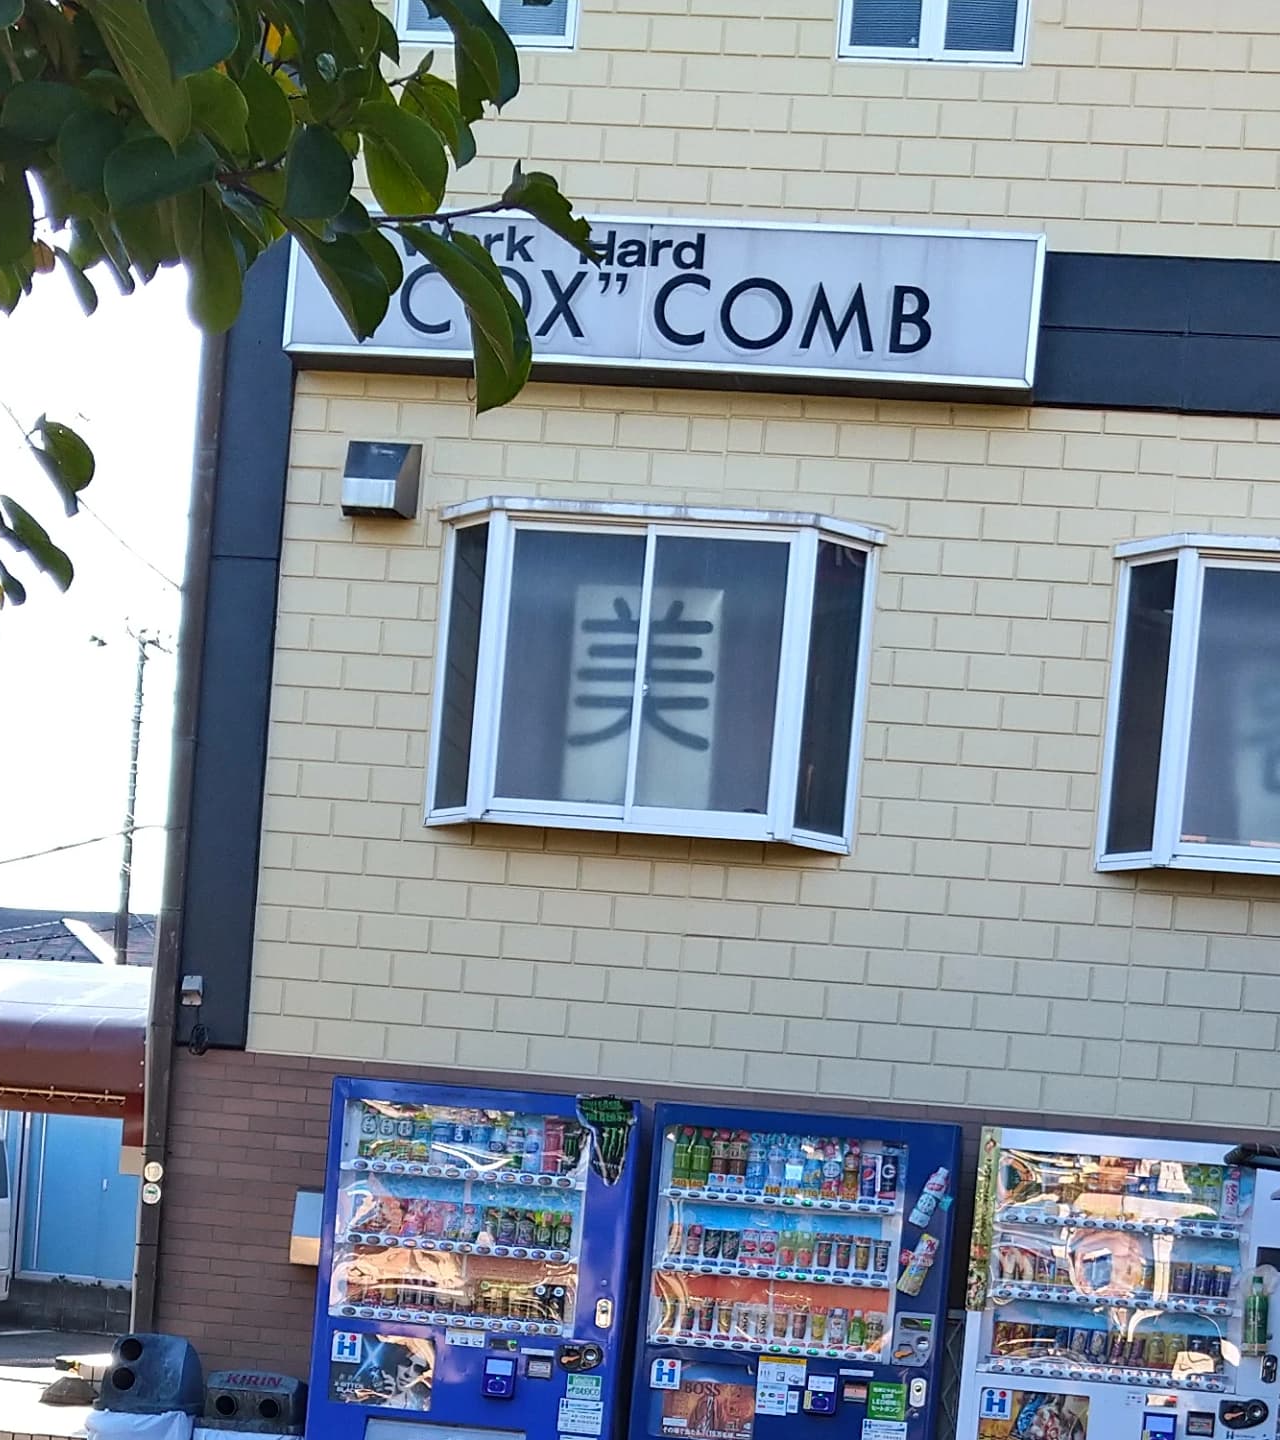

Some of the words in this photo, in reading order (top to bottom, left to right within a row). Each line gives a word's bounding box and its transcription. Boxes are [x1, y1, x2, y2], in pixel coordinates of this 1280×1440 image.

[401, 220, 535, 262] rk
[653, 273, 933, 355] COMB
[227, 1373, 282, 1386] KIRIN
[684, 1383, 721, 1396] BOSS
